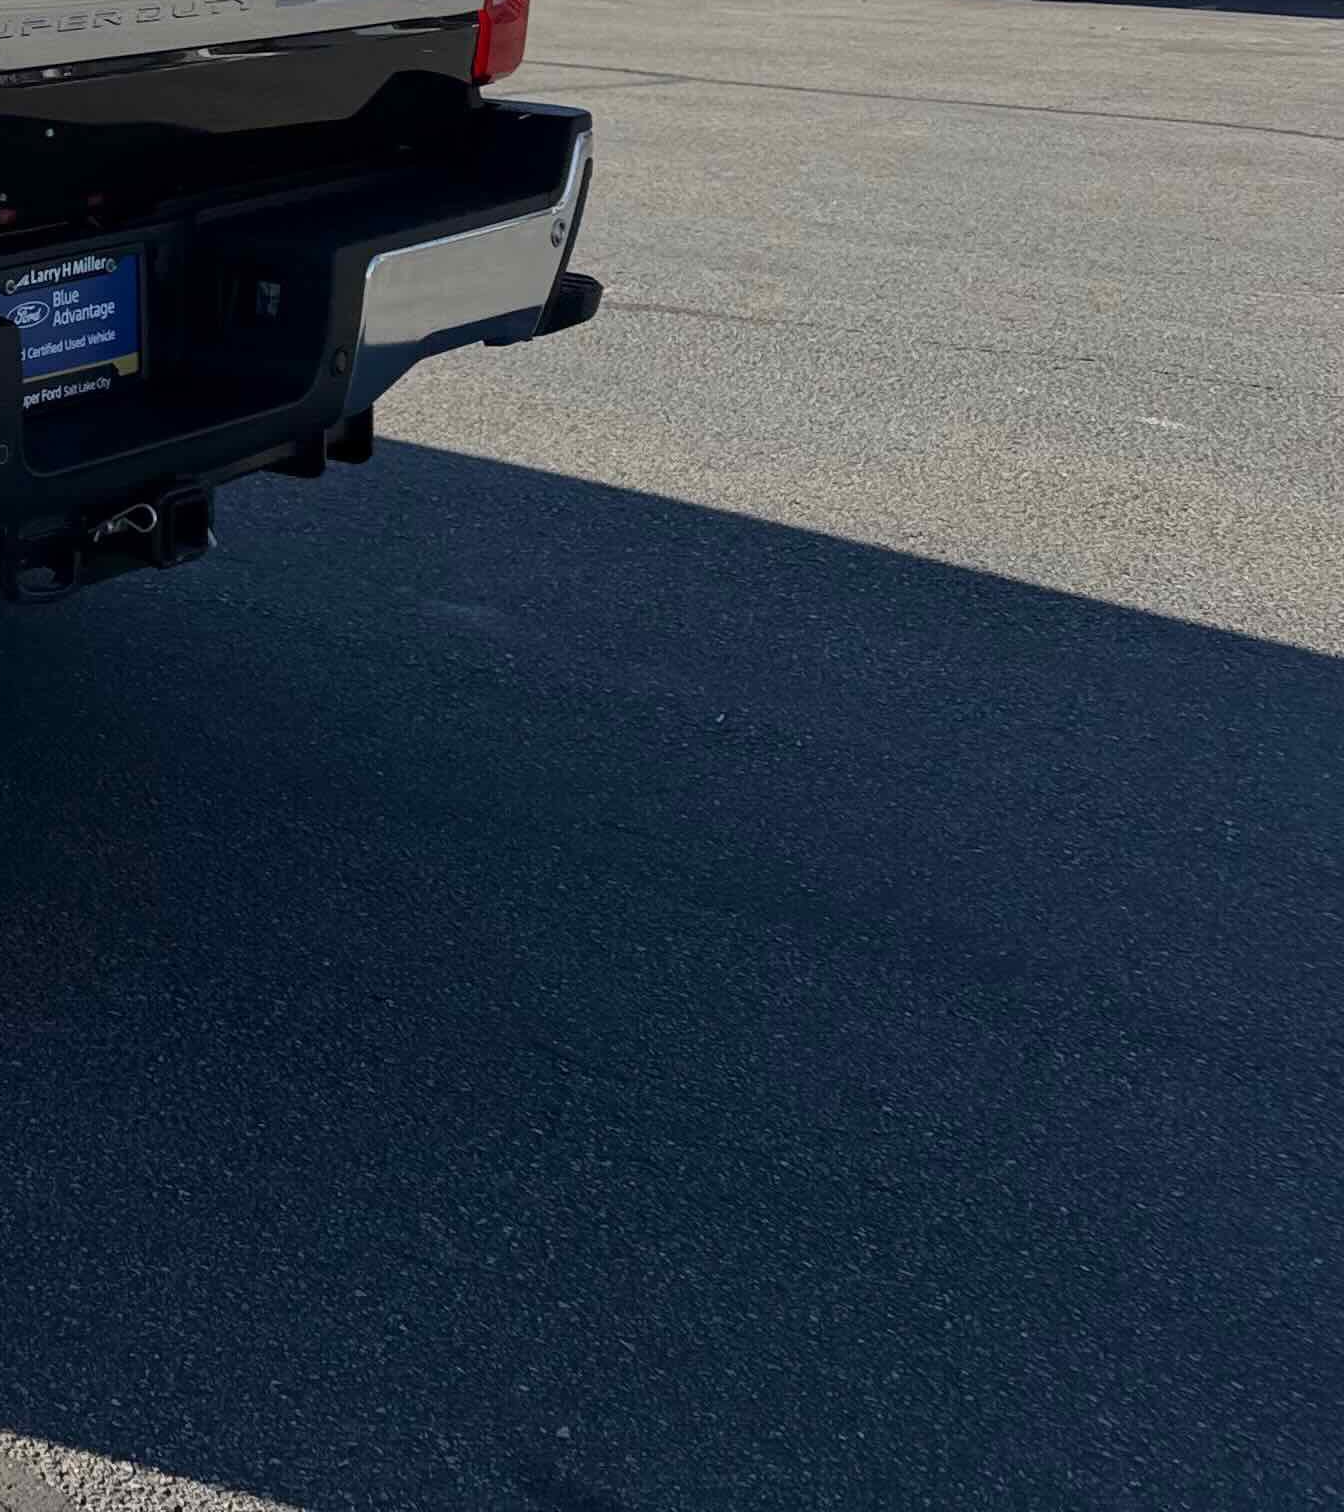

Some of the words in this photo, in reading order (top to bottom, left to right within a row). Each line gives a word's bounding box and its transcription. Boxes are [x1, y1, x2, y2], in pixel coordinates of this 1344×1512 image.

[30, 267, 61, 285] Larry
[62, 261, 72, 278] H
[73, 255, 106, 275] Miller
[52, 289, 80, 307] Blue
[53, 301, 116, 327] Advantage
[27, 340, 63, 360] Certified
[64, 335, 87, 352] Used
[87, 330, 116, 345] Vehicle
[41, 385, 62, 403] Ford
[96, 376, 112, 390] City
